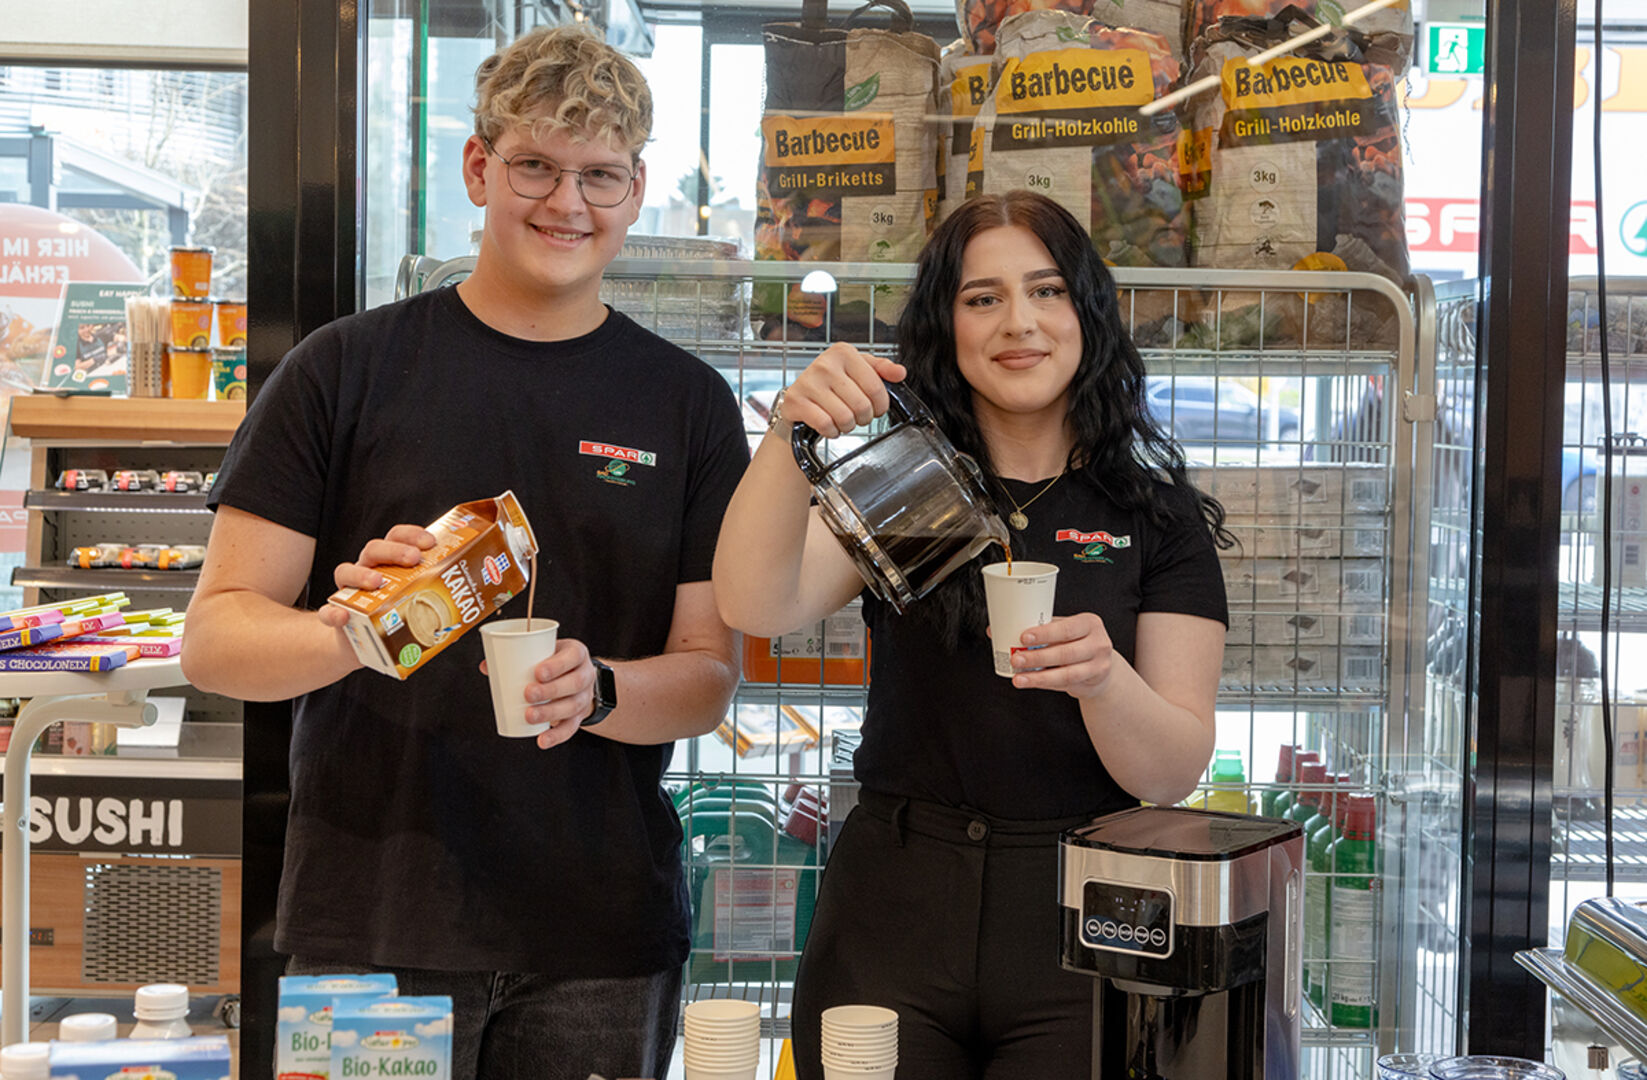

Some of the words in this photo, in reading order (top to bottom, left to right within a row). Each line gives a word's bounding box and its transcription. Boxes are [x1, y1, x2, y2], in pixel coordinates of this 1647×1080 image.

[1011, 62, 1134, 100] Barbecue
[1234, 62, 1349, 97] Barbecue
[1012, 118, 1138, 140] Grill-Holzkohle
[1234, 110, 1361, 137] Grill-Holzkohle
[775, 128, 880, 158] Barbecue
[779, 171, 883, 189] Grill-Briketts
[1028, 174, 1051, 189] 3kg
[1253, 171, 1276, 184] 3kg
[872, 212, 894, 226] 3kg
[592, 445, 638, 459] SPAR
[1069, 531, 1112, 544] SPAR
[441, 564, 480, 624] KAKAO
[29, 796, 184, 846] SUSHI
[342, 1055, 437, 1077] Bio-Kakao
